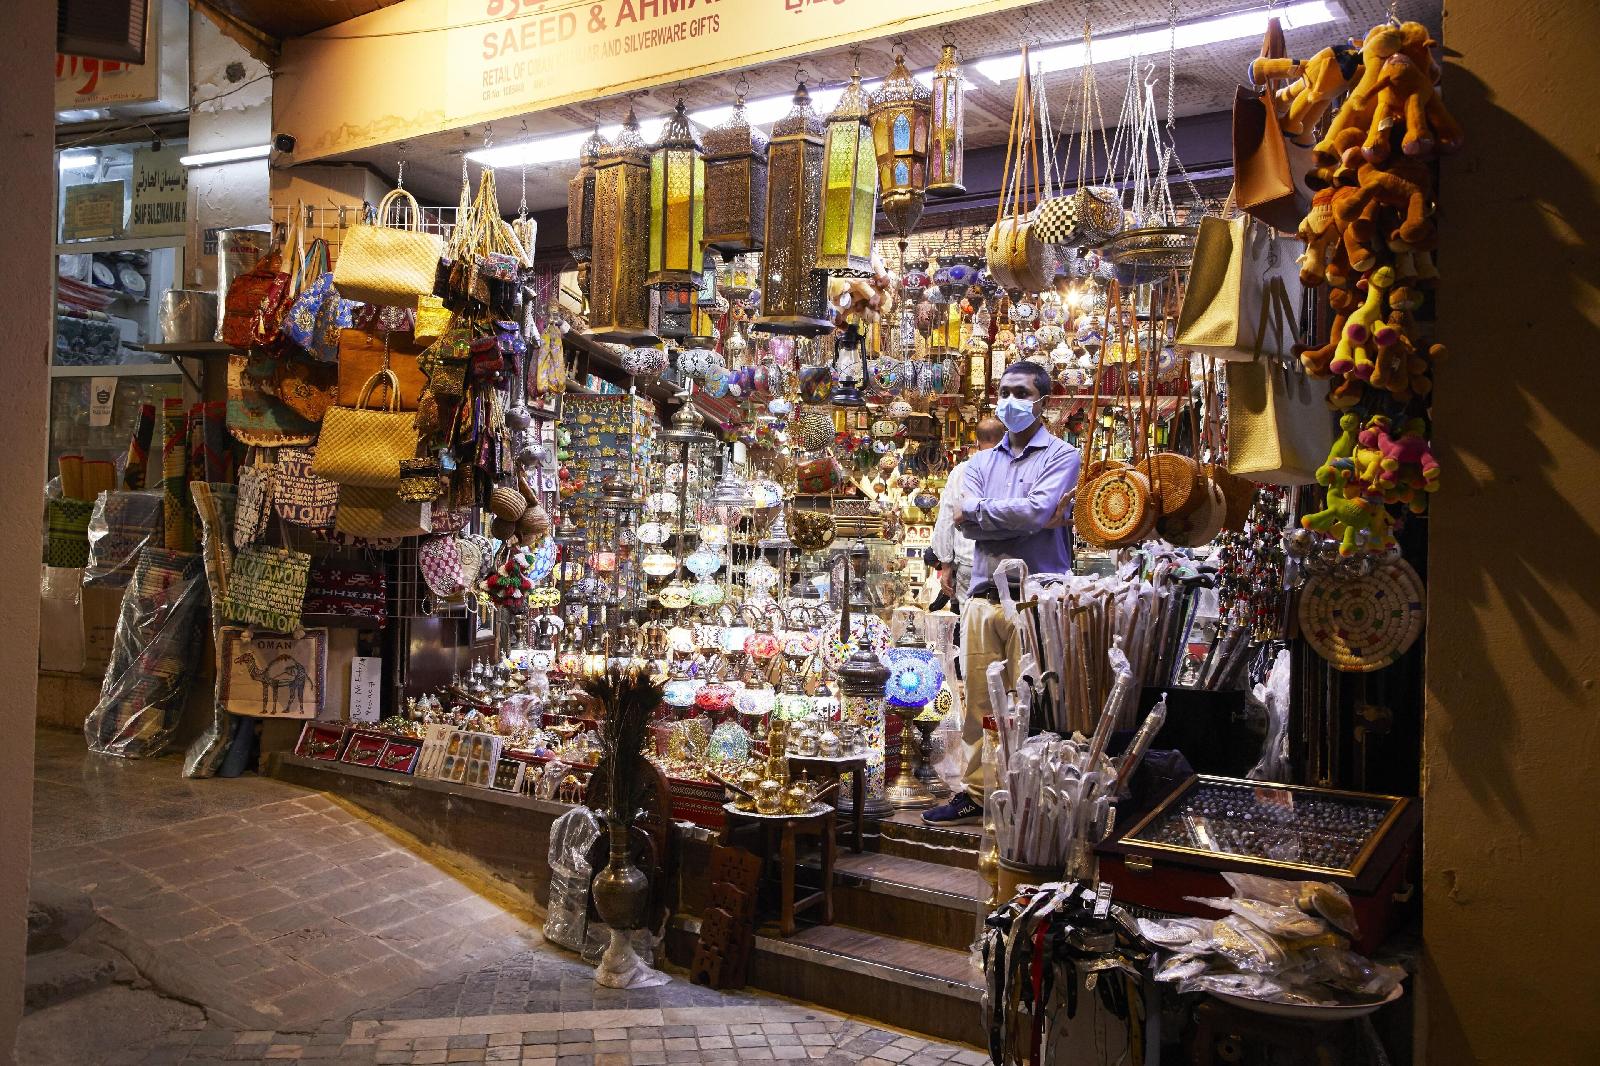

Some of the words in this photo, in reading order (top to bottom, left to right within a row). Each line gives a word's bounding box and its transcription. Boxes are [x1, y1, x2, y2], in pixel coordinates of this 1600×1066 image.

[482, 12, 577, 60] SAEED
[587, 4, 607, 33] &
[482, 64, 512, 88] RETAIL
[602, 39, 621, 57] AND
[624, 22, 687, 54] SILVERWARE
[689, 13, 720, 38] GIFTS
[134, 203, 147, 225] SAIF
[257, 640, 293, 650] OMAN
